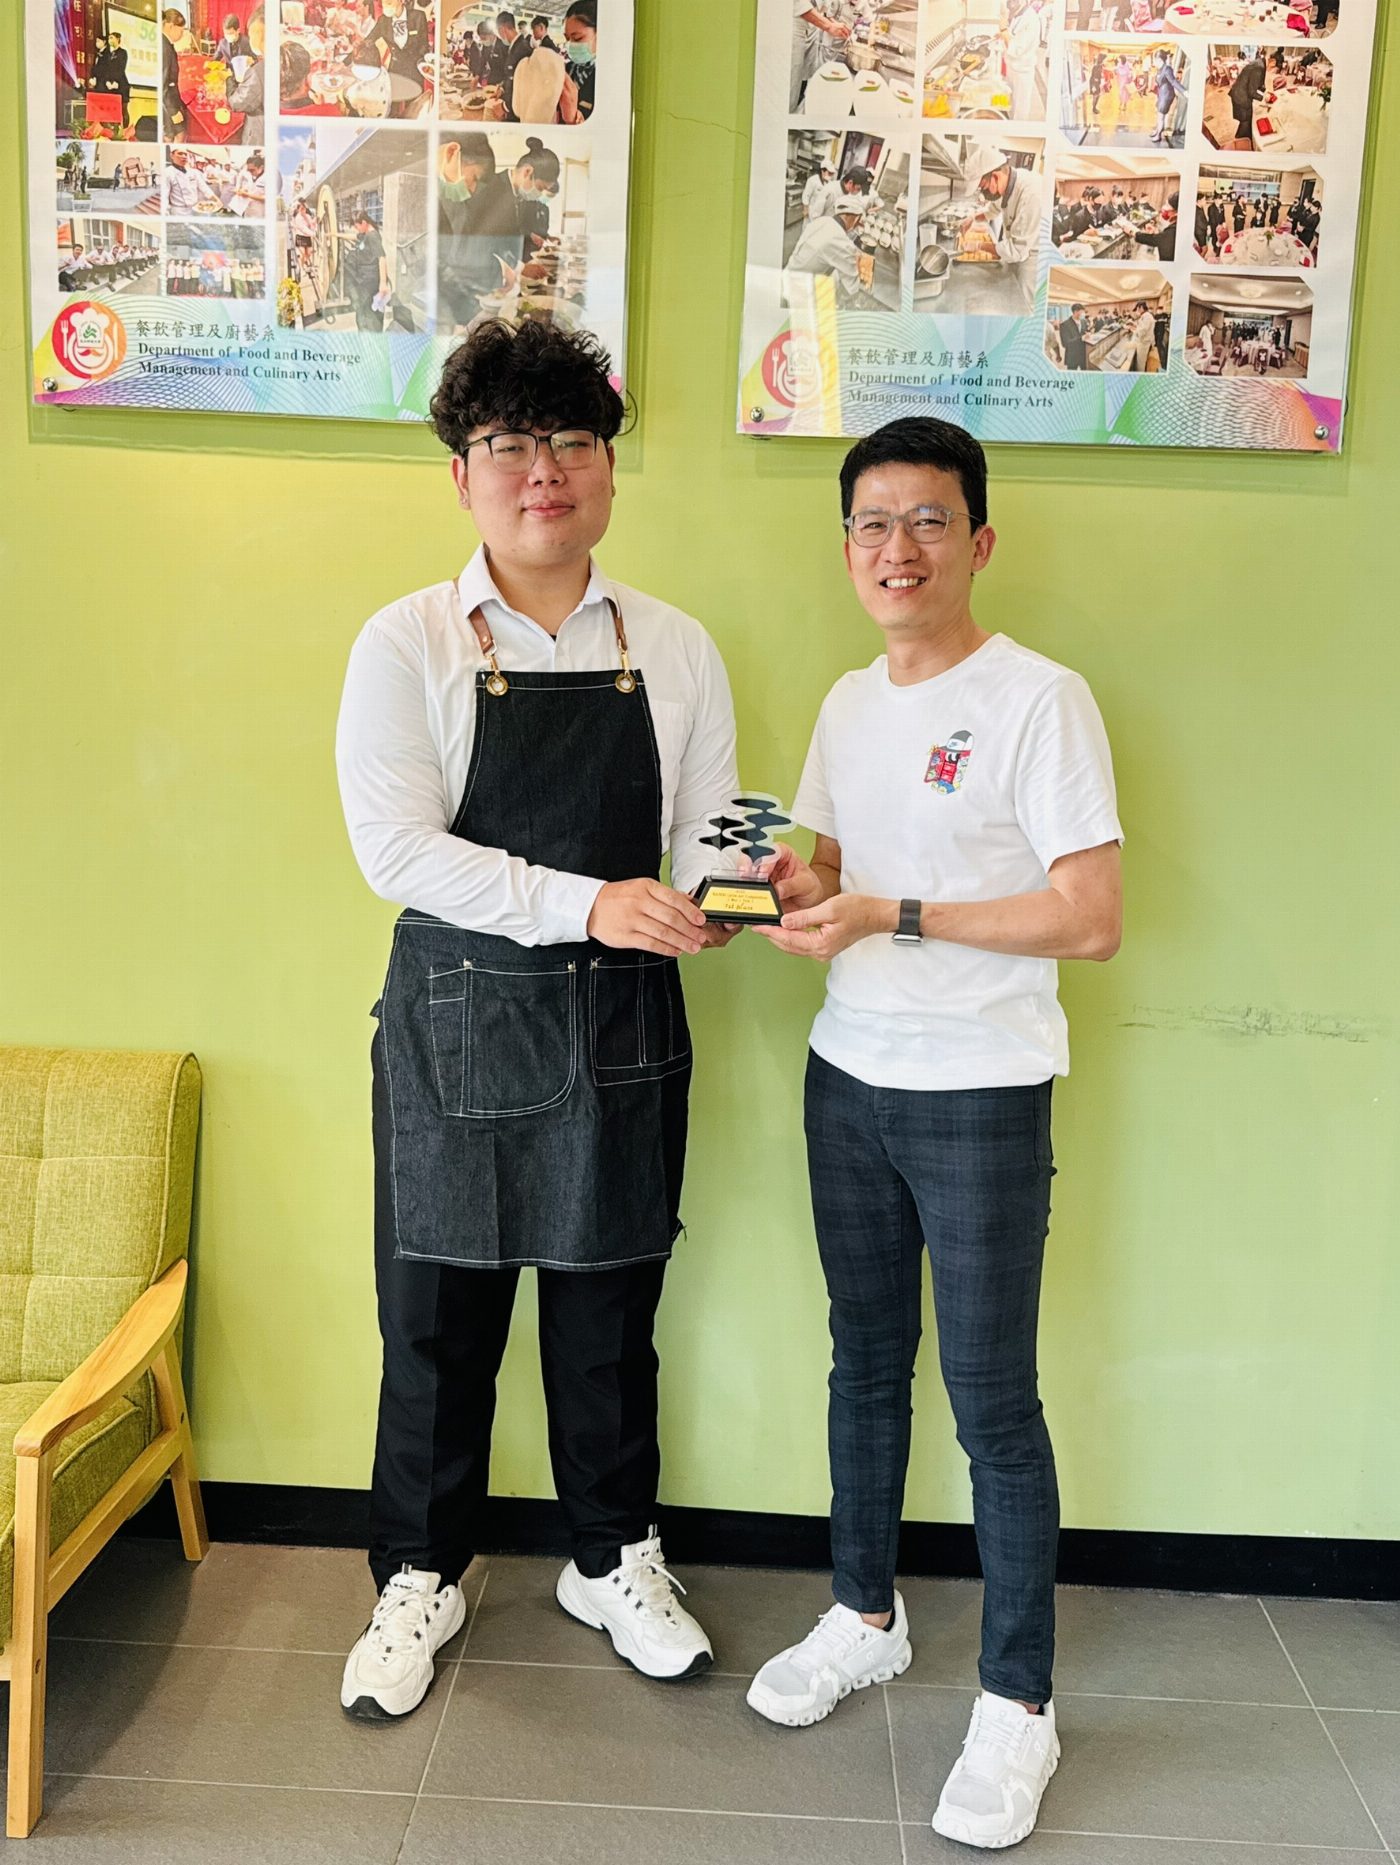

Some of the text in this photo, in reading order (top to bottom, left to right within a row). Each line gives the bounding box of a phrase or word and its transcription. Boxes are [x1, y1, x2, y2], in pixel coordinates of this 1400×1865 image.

[136, 319, 276, 342] 餐飲管理及廚藝系
[138, 342, 361, 364] Department of Food and Beverage
[848, 347, 989, 369] 餐飲管理及廚藝系
[139, 361, 341, 383] Management and Culinary Arts
[849, 370, 1075, 390] Department of Food and Beverage
[849, 389, 1054, 409] Management and Culinary Arts
